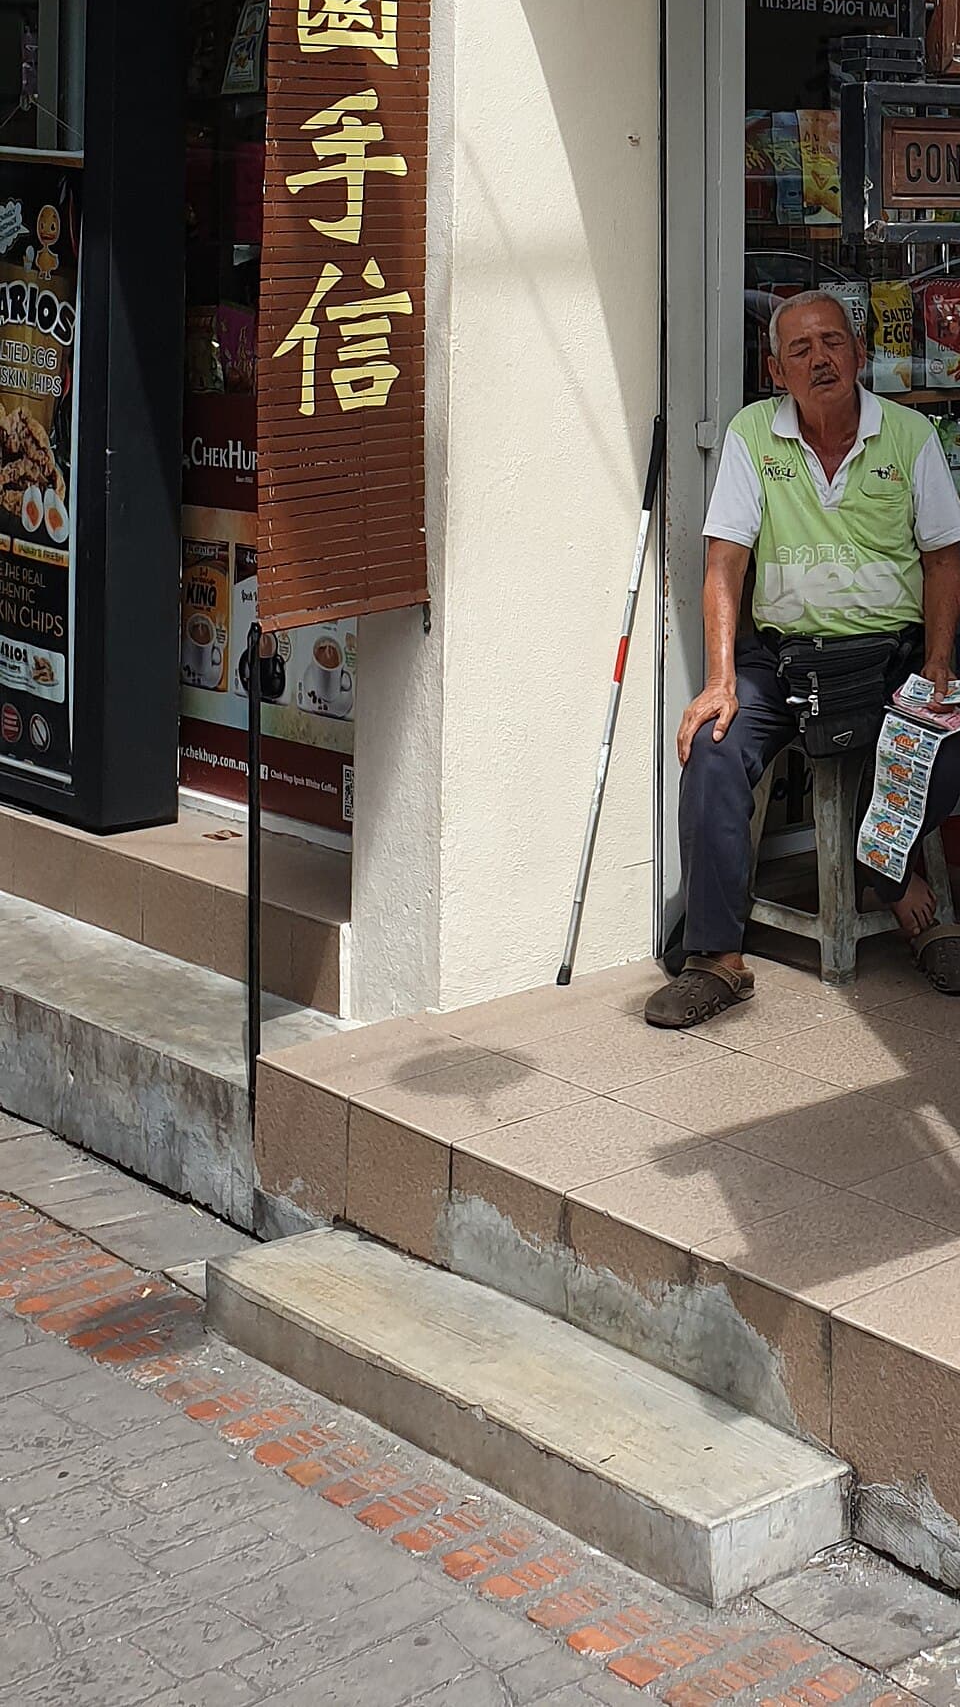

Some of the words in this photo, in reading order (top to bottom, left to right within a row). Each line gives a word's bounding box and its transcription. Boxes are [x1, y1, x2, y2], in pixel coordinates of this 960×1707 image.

[0, 365, 29, 390] SKIN
[31, 372, 62, 397] HIPS
[20, 606, 64, 637] CHIPS
